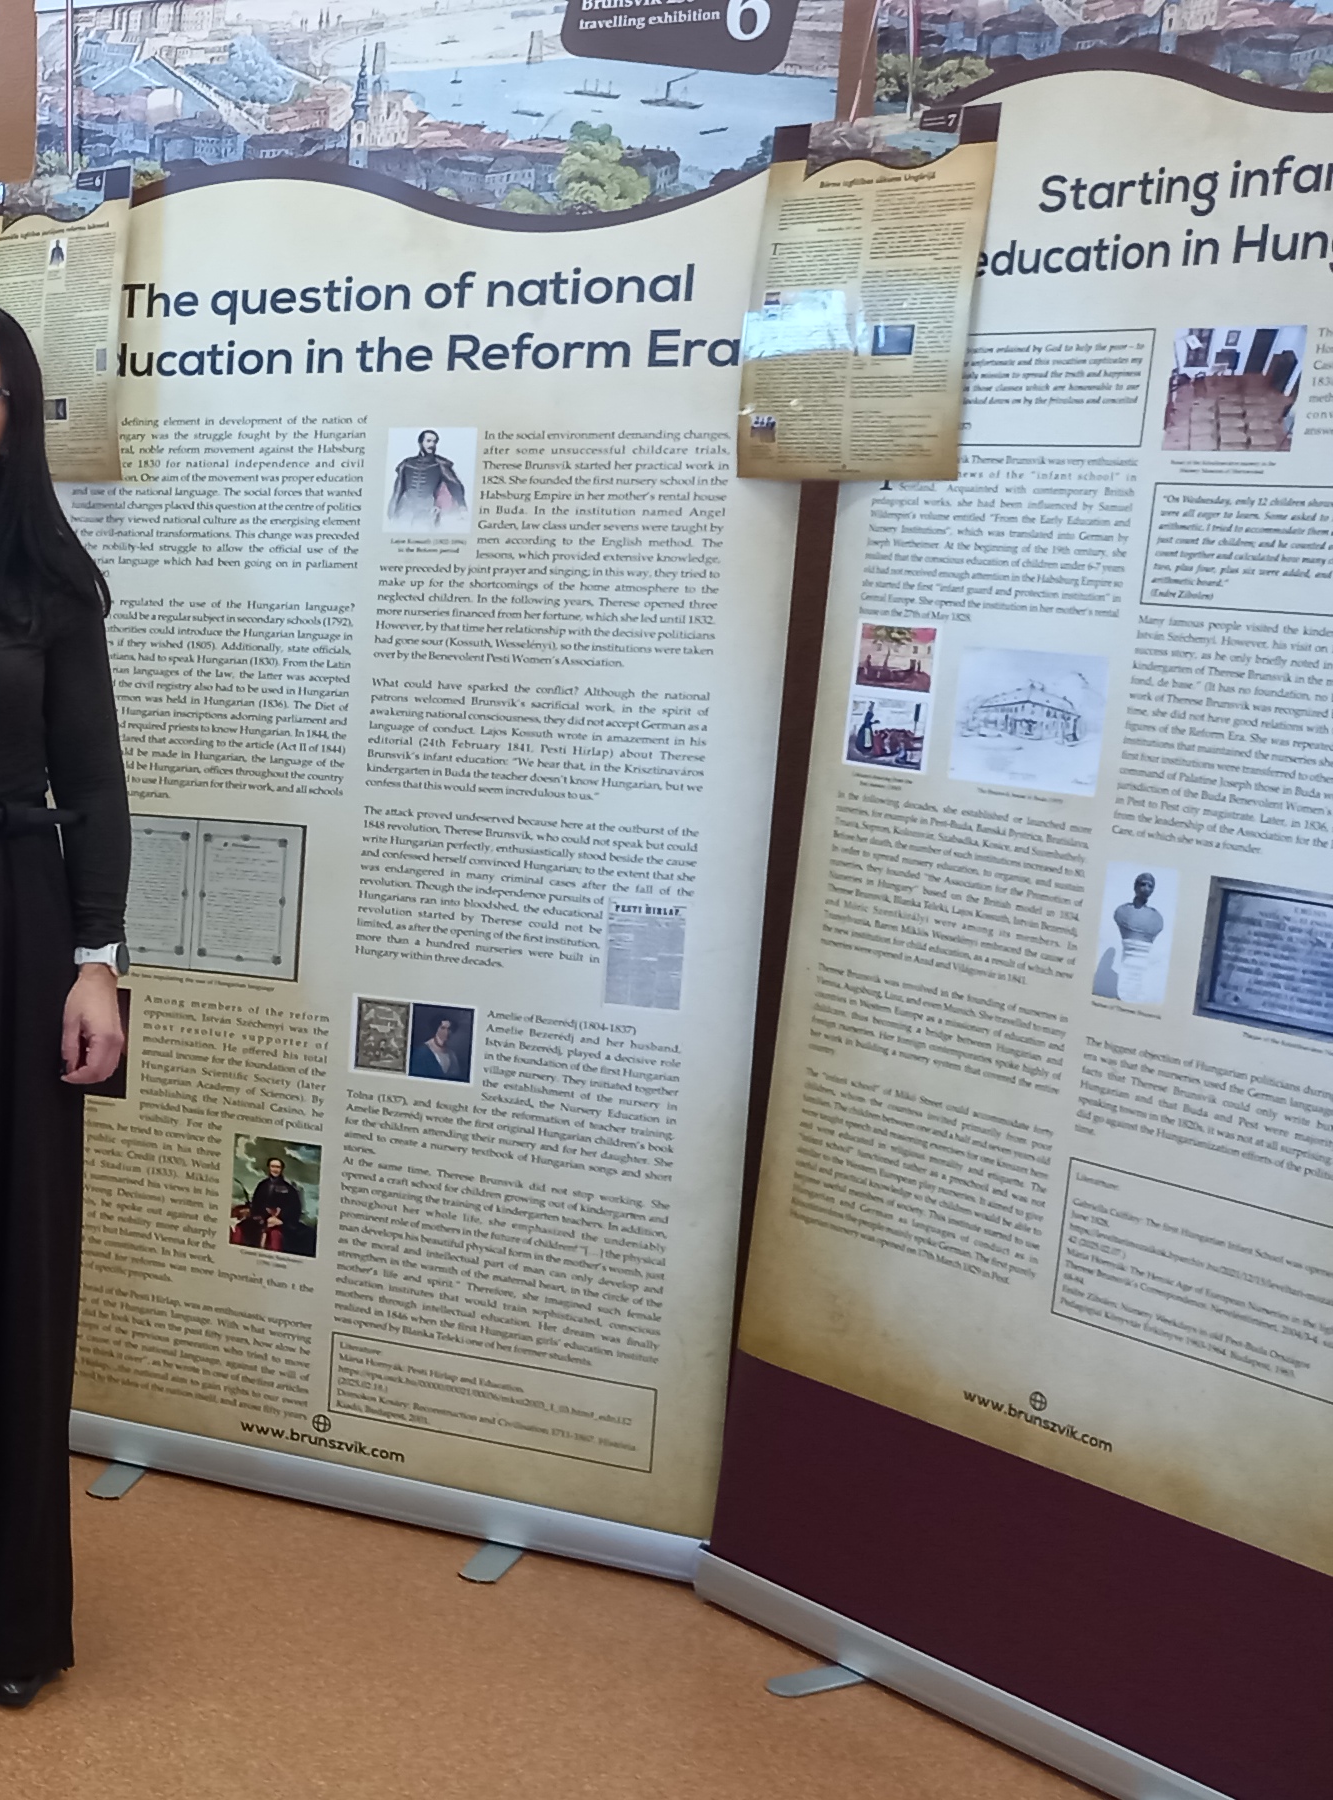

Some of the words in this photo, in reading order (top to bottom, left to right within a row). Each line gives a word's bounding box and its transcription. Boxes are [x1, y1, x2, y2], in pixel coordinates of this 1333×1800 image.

[578, 14, 646, 30] travelling
[648, 8, 721, 25] exhibition
[726, 0, 771, 41] 6
[1038, 166, 1220, 217] Starting
[1229, 154, 1333, 199] infa
[1181, 228, 1220, 267] in
[1232, 223, 1333, 273] Hun
[121, 282, 199, 319] The
[210, 275, 411, 326] question
[424, 270, 477, 310] of
[486, 262, 696, 308] national
[305, 338, 343, 374] in
[355, 335, 433, 373] the
[446, 331, 631, 372] Reform
[647, 328, 741, 368] Era
[483, 429, 495, 440] In
[497, 429, 514, 440] the
[613, 460, 632, 470] her
[717, 460, 729, 470] in
[513, 682, 530, 694] the
[640, 688, 658, 699] the
[523, 1013, 534, 1023] of
[240, 1416, 406, 1464] www.brunszvik.com
[963, 1389, 1114, 1454] www.brunszvik.com
